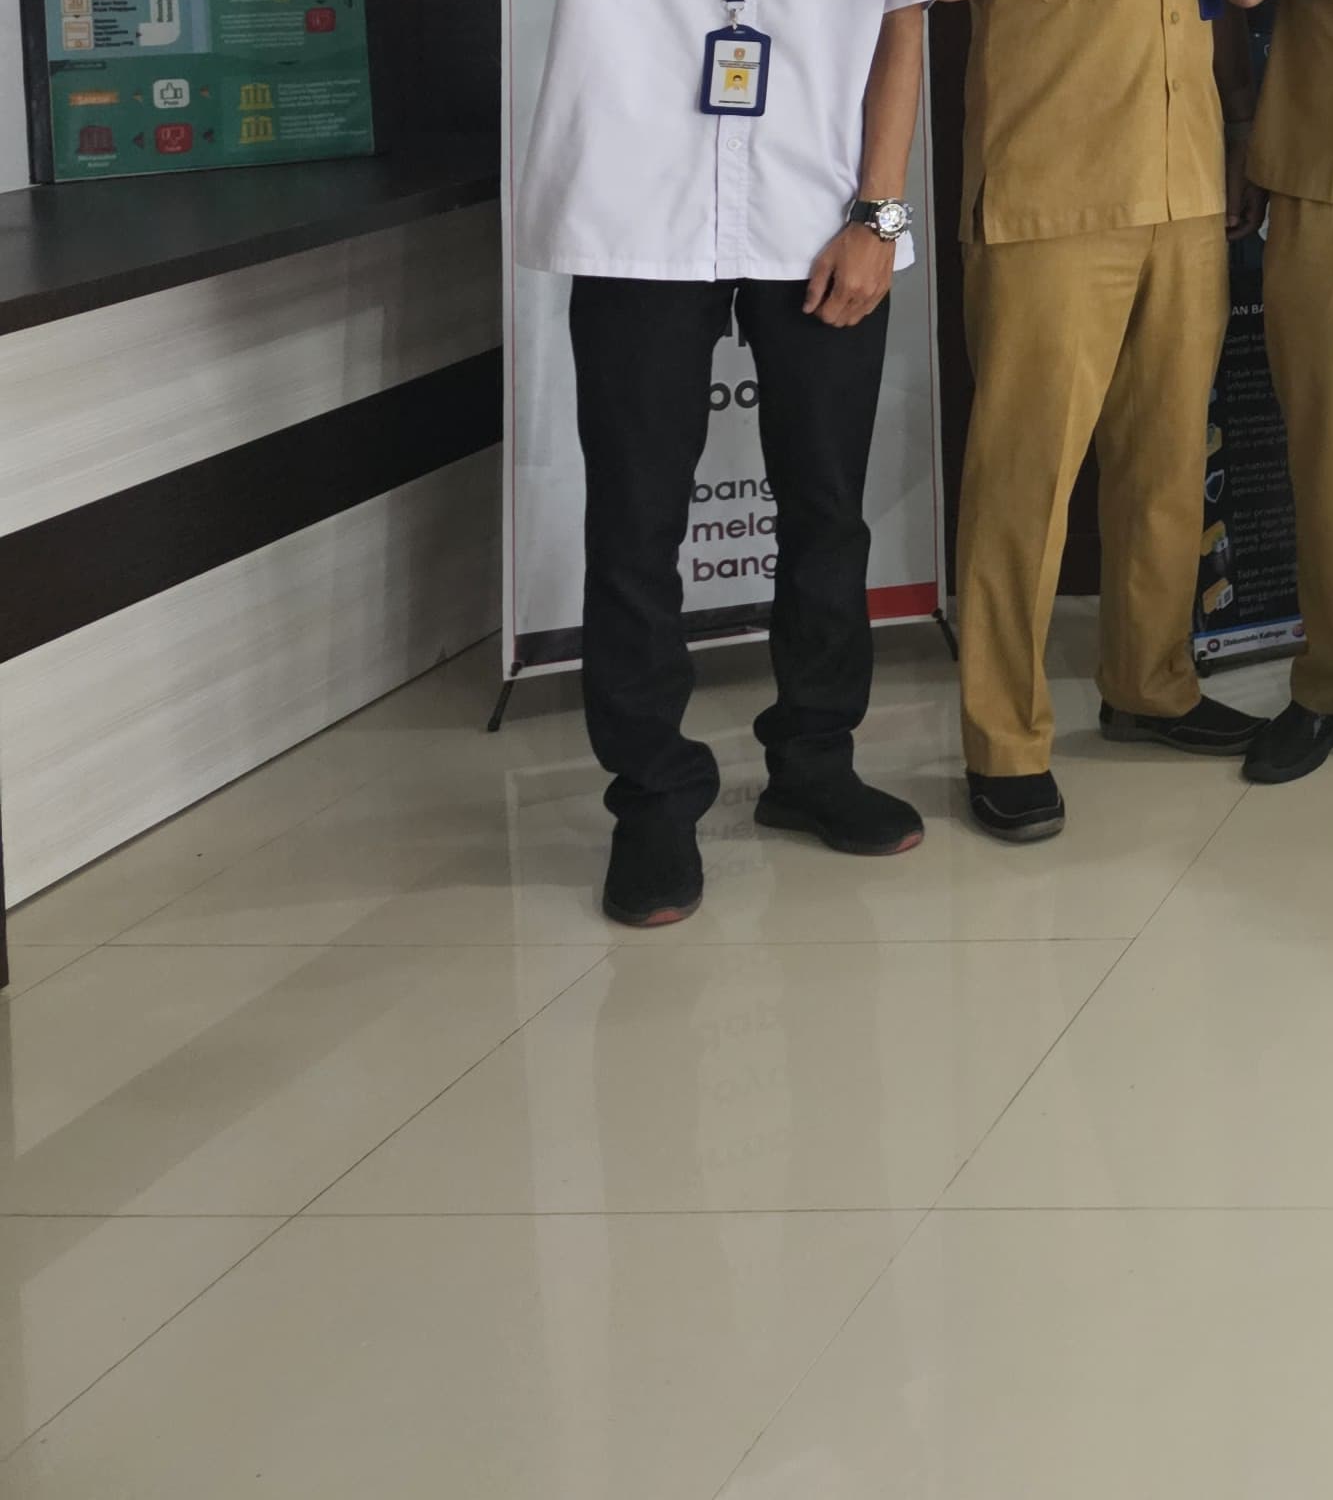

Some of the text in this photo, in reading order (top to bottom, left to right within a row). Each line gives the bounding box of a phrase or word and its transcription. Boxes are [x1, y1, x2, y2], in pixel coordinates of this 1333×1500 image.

[694, 476, 774, 503] bang
[691, 512, 777, 544] mela
[691, 553, 779, 582] bang
